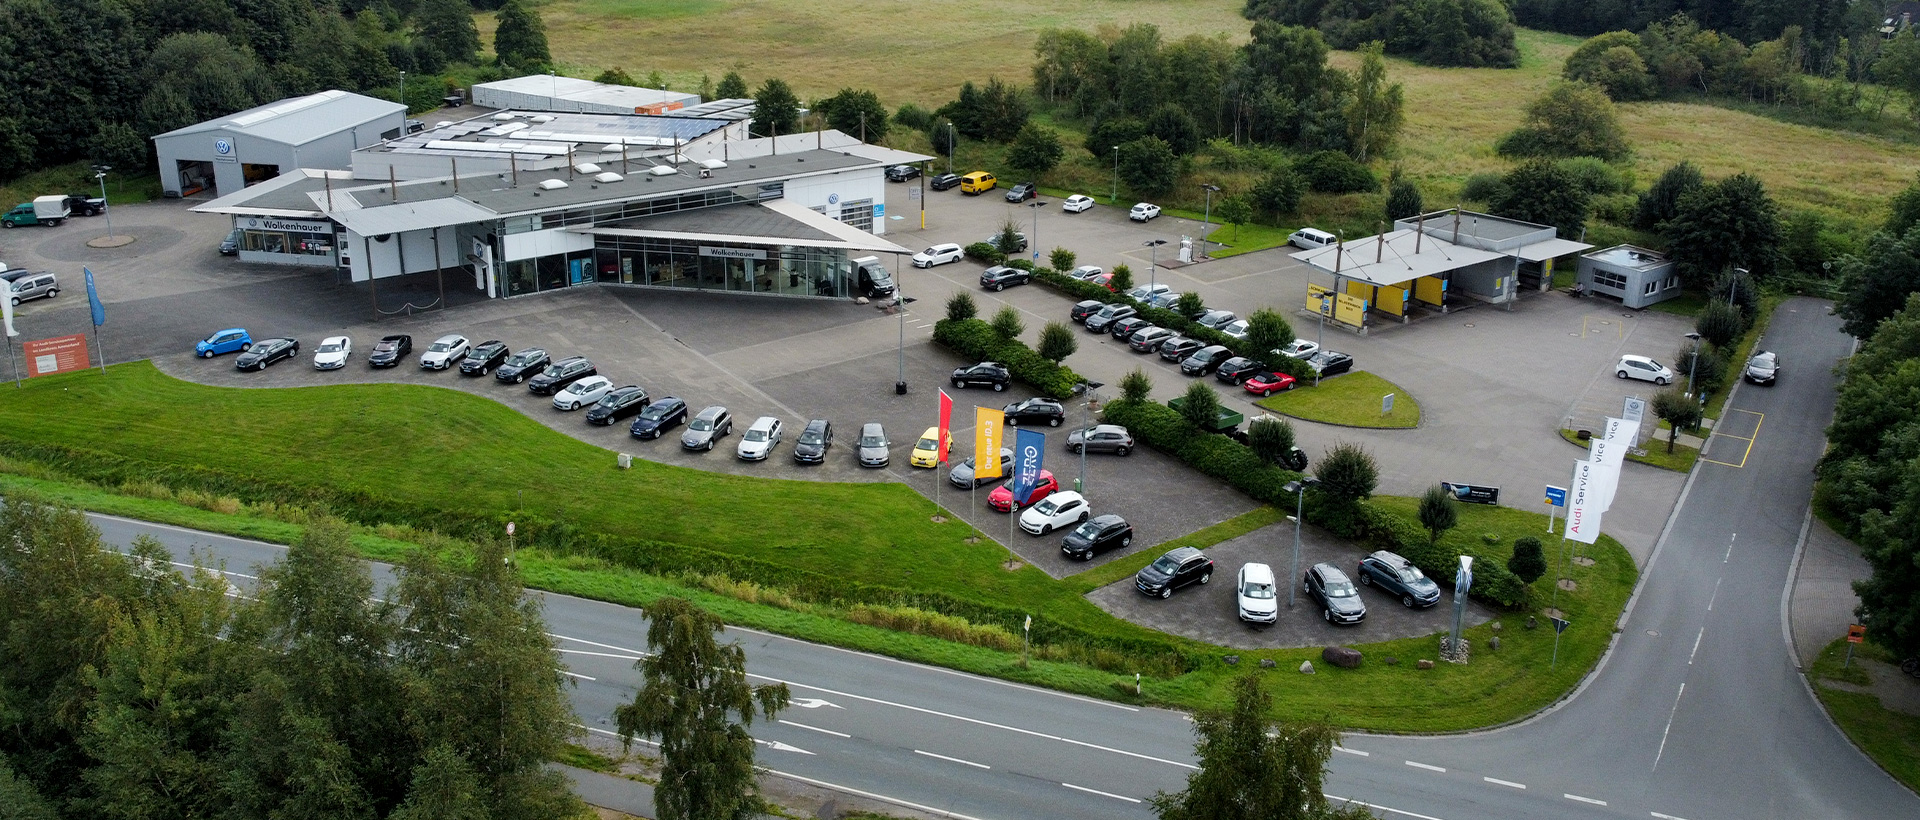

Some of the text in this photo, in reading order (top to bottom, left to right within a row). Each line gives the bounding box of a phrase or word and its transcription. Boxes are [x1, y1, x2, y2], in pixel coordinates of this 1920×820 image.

[263, 220, 322, 231] Wolkenhauer
[711, 248, 754, 257] Wolkenhauer
[985, 420, 993, 470] Der neue ID.3
[1022, 445, 1038, 487] ZERO
[1571, 465, 1589, 533] Audi Service
